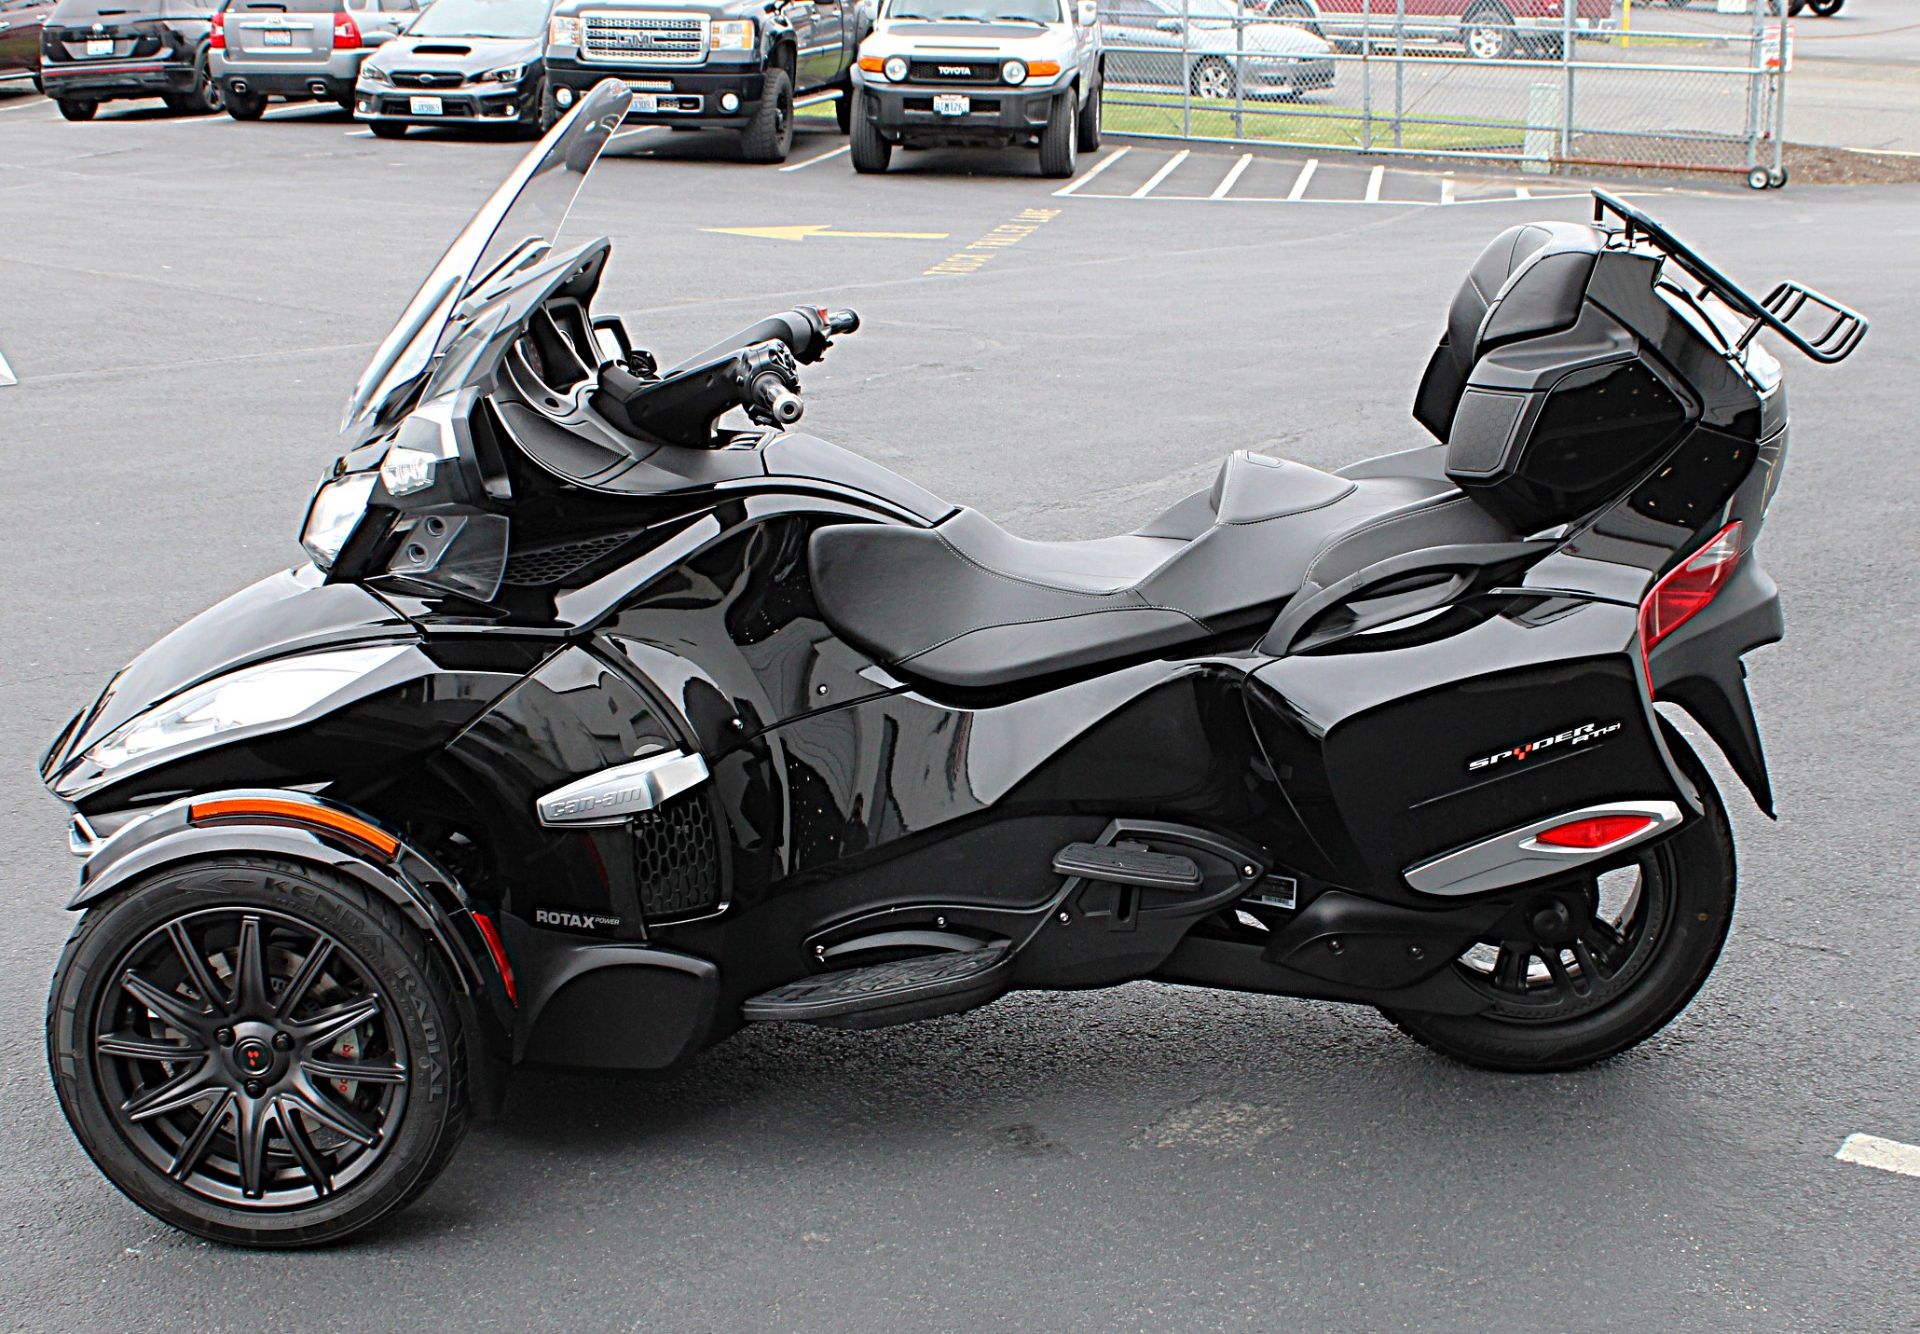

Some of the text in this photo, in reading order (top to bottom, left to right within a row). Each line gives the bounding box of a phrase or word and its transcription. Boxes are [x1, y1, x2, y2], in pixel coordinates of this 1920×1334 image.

[938, 66, 971, 75] TOYOTA
[1469, 722, 1595, 770] SPYDER
[550, 787, 641, 818] can-am
[264, 876, 385, 957] KENDA
[536, 910, 620, 929] ROTAX POWER
[394, 966, 444, 1102] RADIAL
